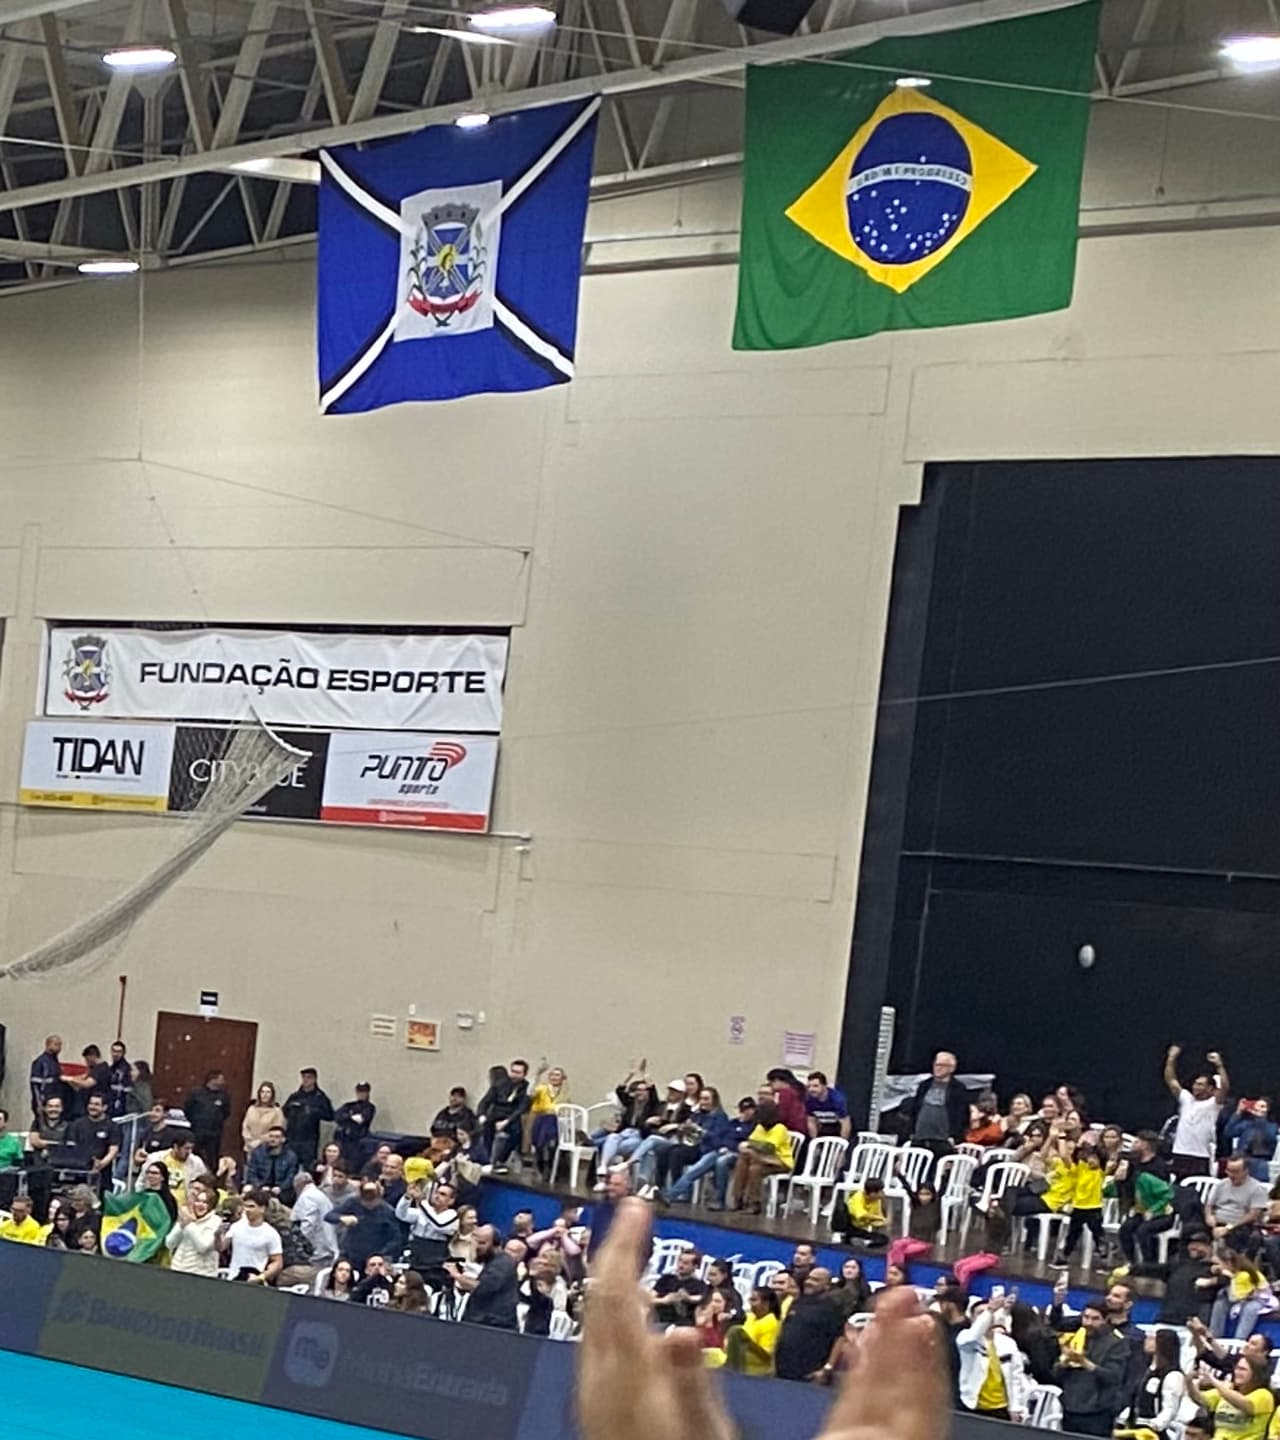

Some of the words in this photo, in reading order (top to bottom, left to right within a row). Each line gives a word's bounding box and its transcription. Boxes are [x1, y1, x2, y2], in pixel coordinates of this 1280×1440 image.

[140, 658, 319, 695] FUNDAÇÃO
[327, 669, 486, 694] ESPORTE
[53, 737, 144, 775] TIDAN
